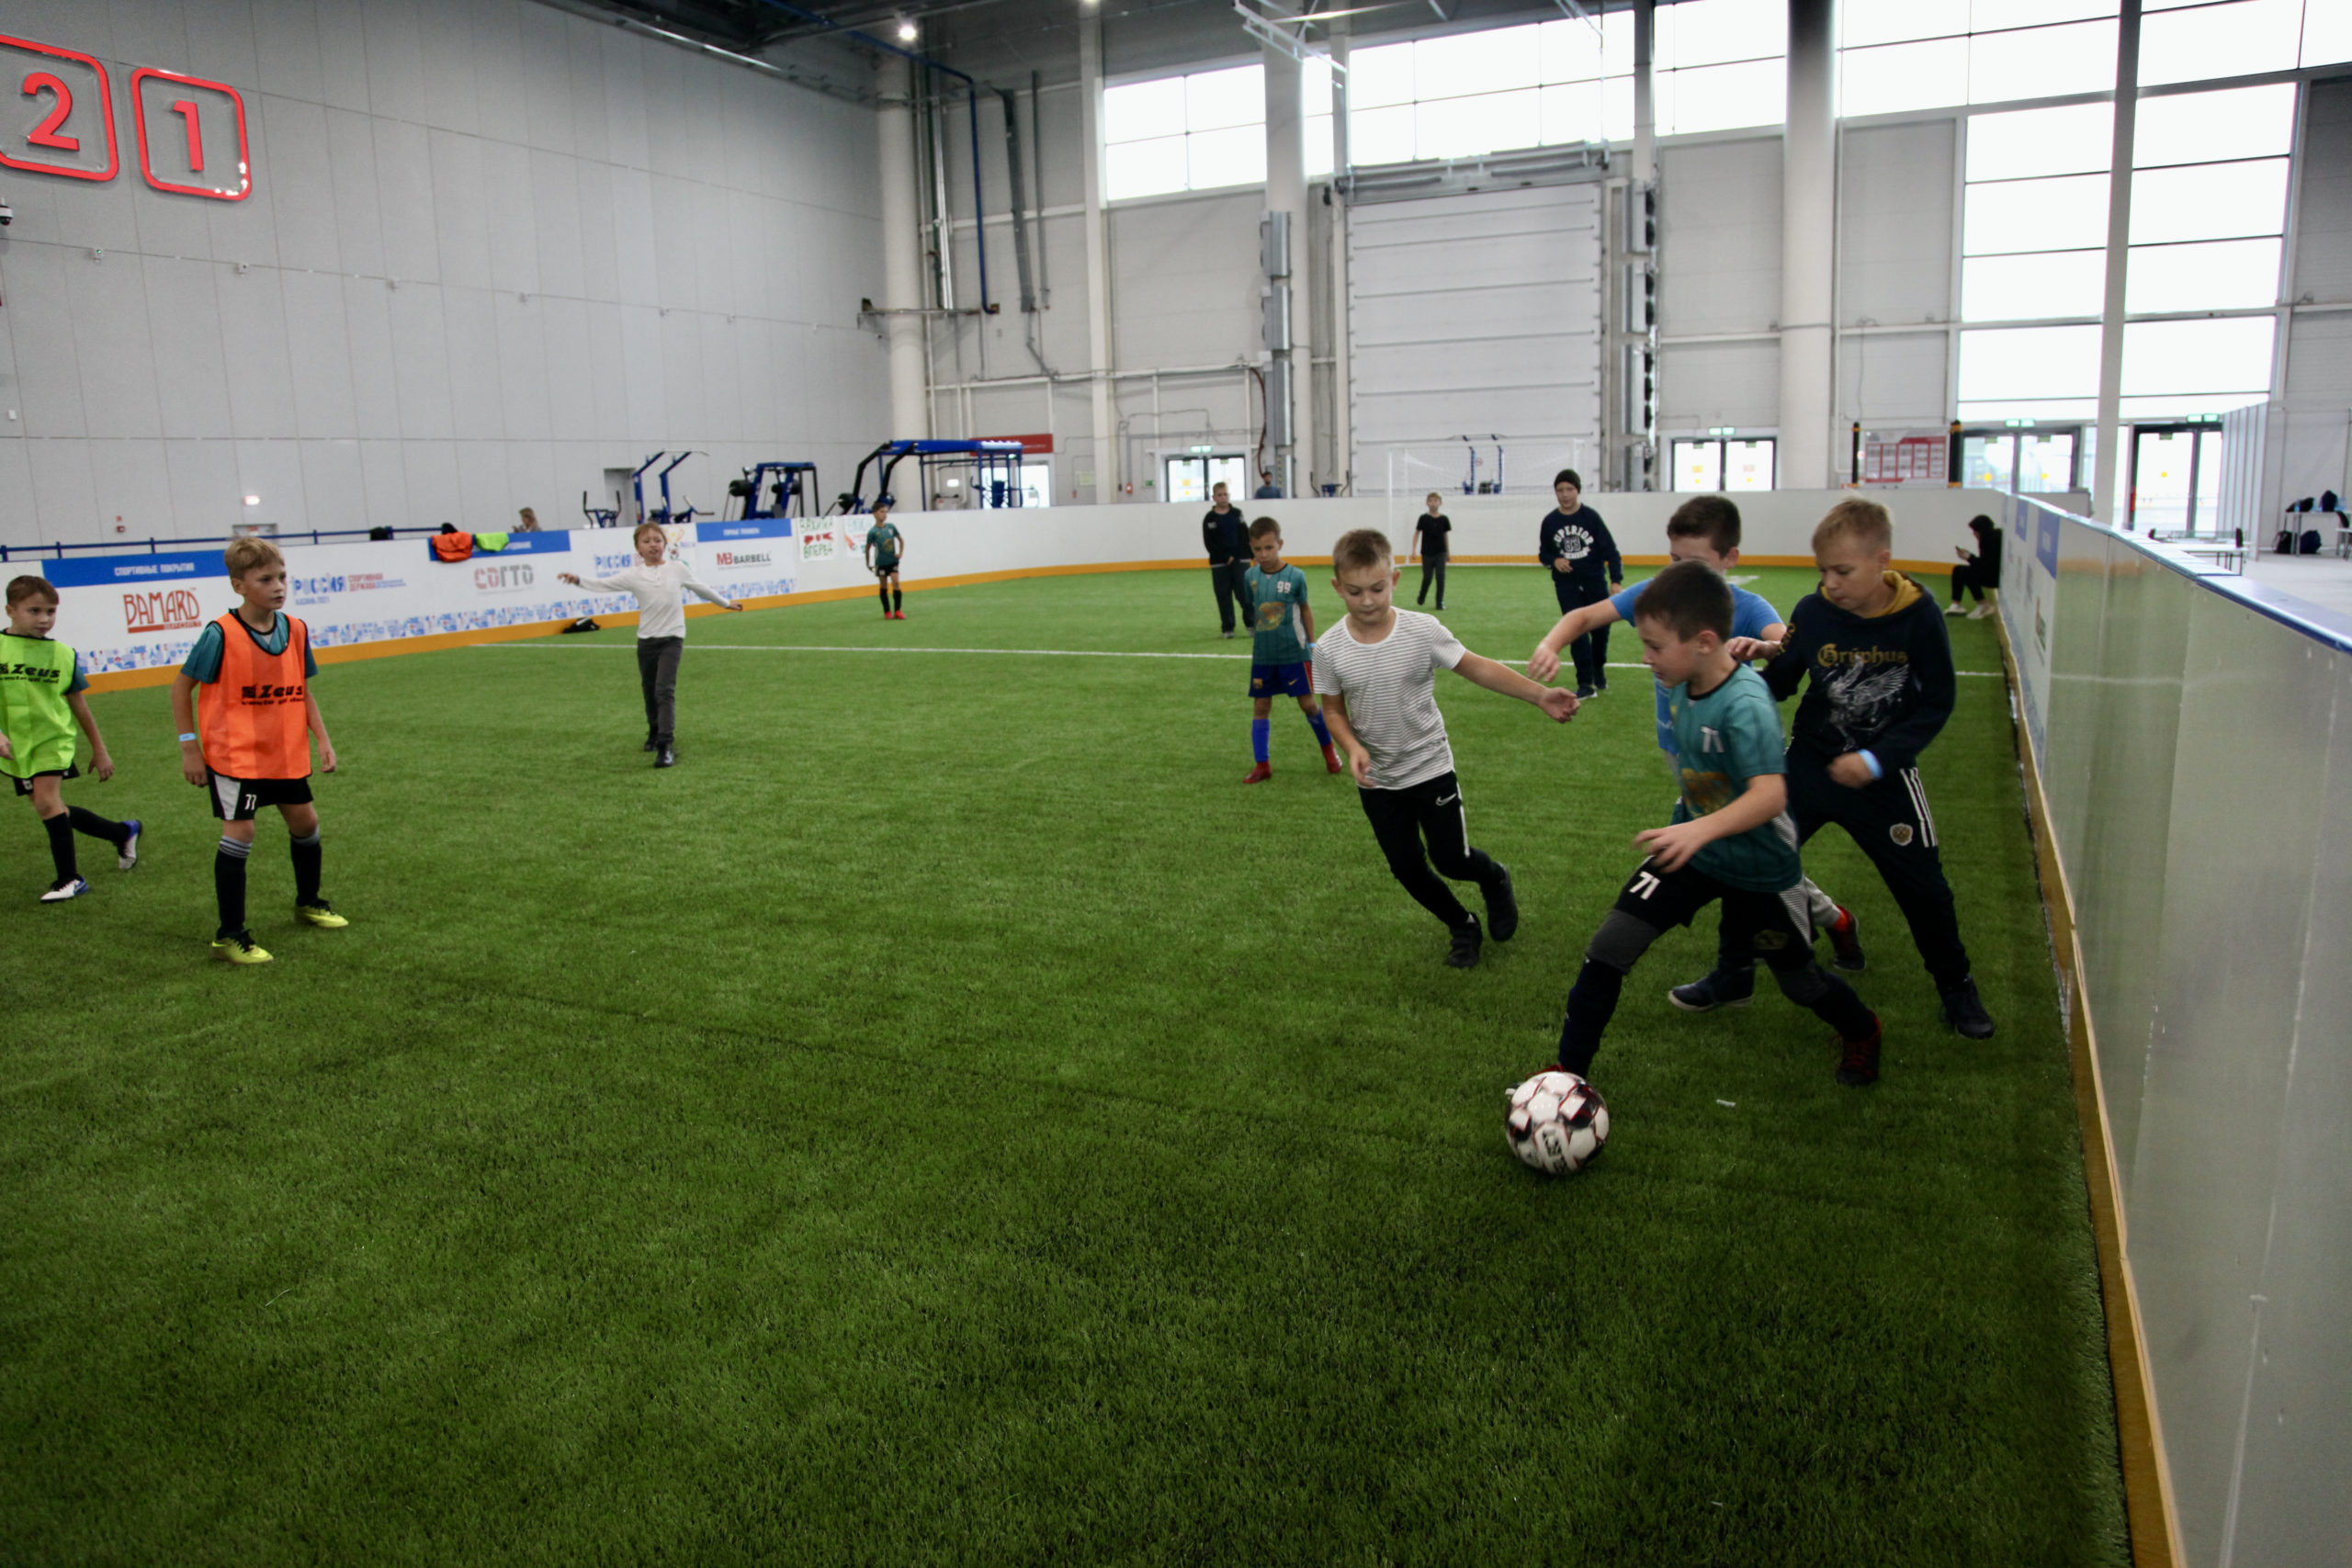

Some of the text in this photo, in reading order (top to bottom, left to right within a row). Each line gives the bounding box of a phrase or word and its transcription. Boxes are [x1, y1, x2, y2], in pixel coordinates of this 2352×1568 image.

[23, 72, 204, 172] 2 1
[734, 553, 772, 564] BARBELL
[122, 590, 199, 626] BAMARD
[11, 663, 61, 678] Zeus
[258, 684, 302, 699] Zeus
